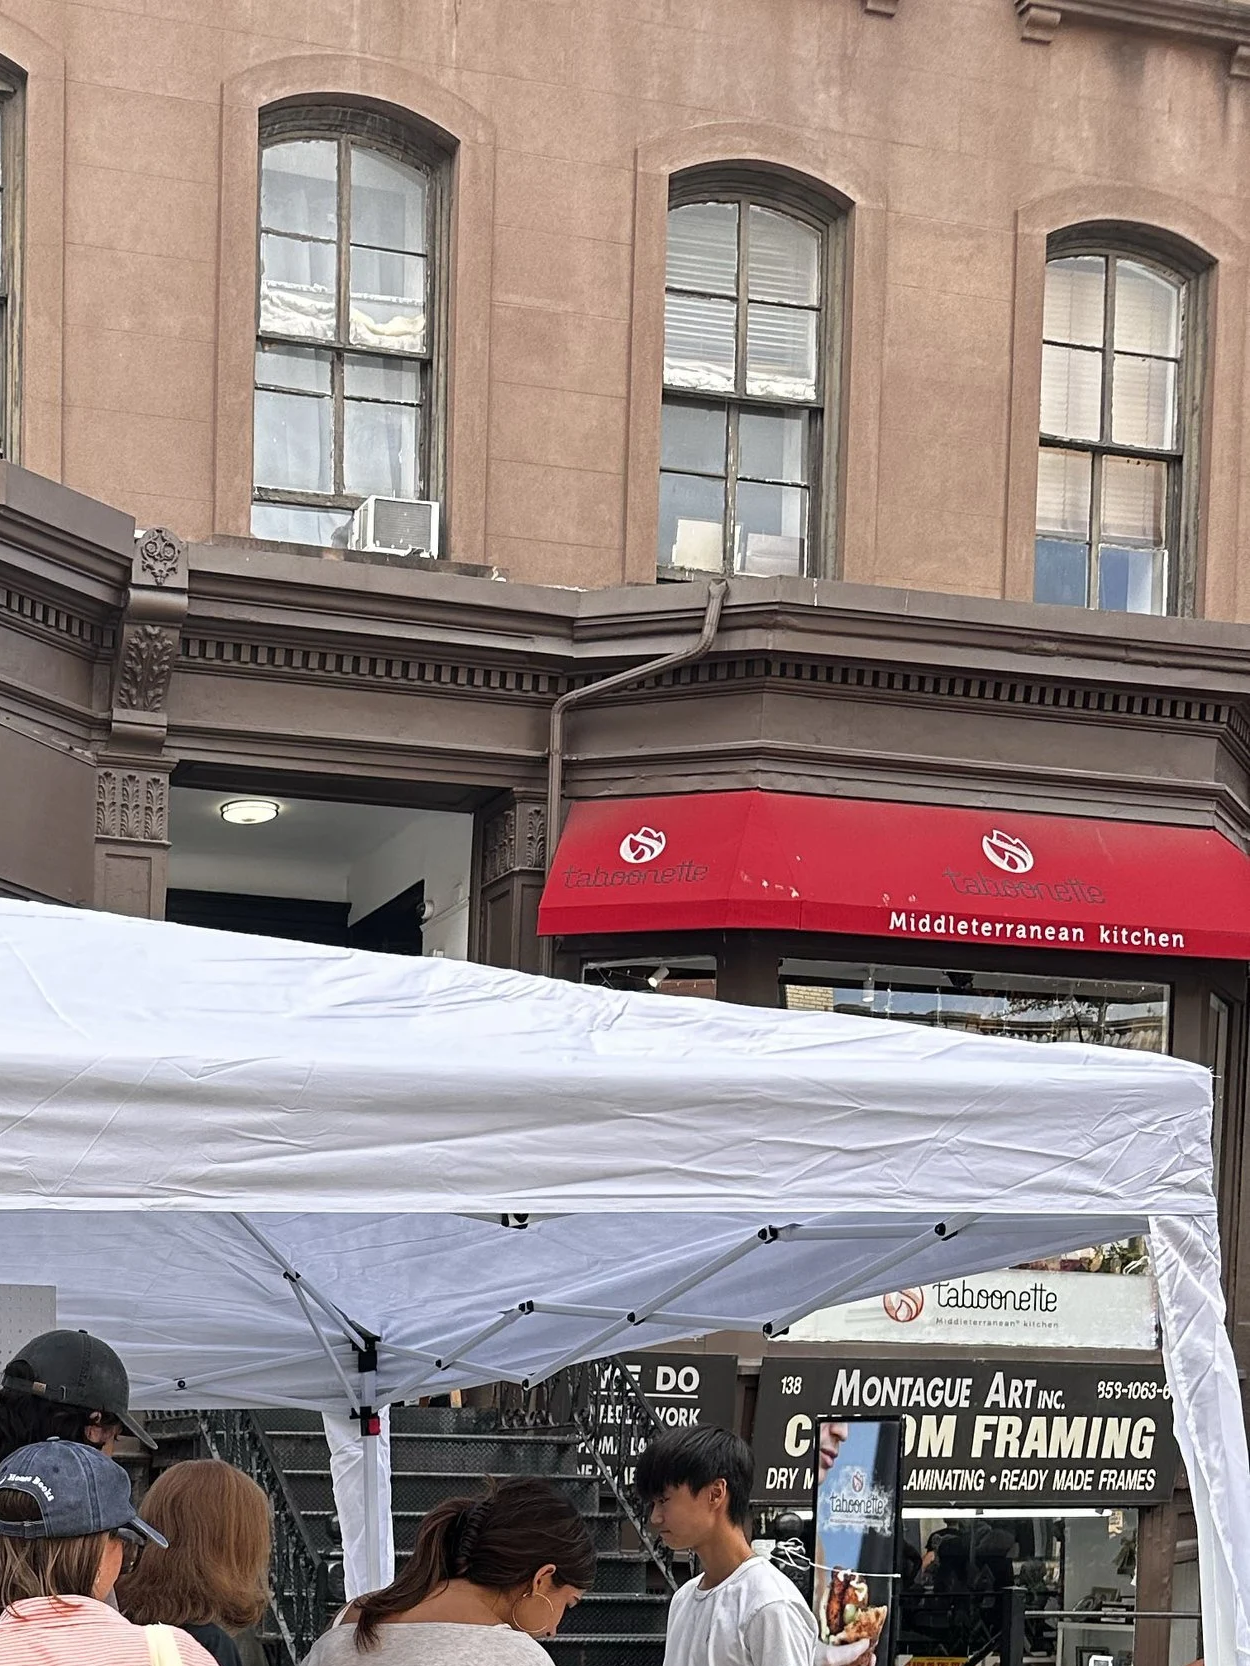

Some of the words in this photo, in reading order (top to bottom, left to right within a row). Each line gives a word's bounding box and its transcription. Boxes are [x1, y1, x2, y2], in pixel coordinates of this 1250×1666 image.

[563, 860, 708, 888] taboonette
[942, 866, 1106, 904] taboonette
[888, 911, 1085, 943] Middleterranean
[1099, 925, 1185, 948] kitchen
[932, 1279, 1058, 1313] taboonette
[1023, 1320, 1059, 1328] kitchen
[655, 1365, 700, 1393] DO
[781, 1376, 802, 1395] 138
[831, 1369, 972, 1408] MONTAGUE
[983, 1371, 1038, 1409] ART
[1037, 1390, 1066, 1410] INC.
[971, 1416, 1157, 1459] FRAMING
[766, 1468, 797, 1490] DRY
[902, 1468, 986, 1492] AMINATING
[999, 1468, 1049, 1492] READY
[1052, 1469, 1093, 1493] MADE
[1098, 1469, 1157, 1493] FRAMES
